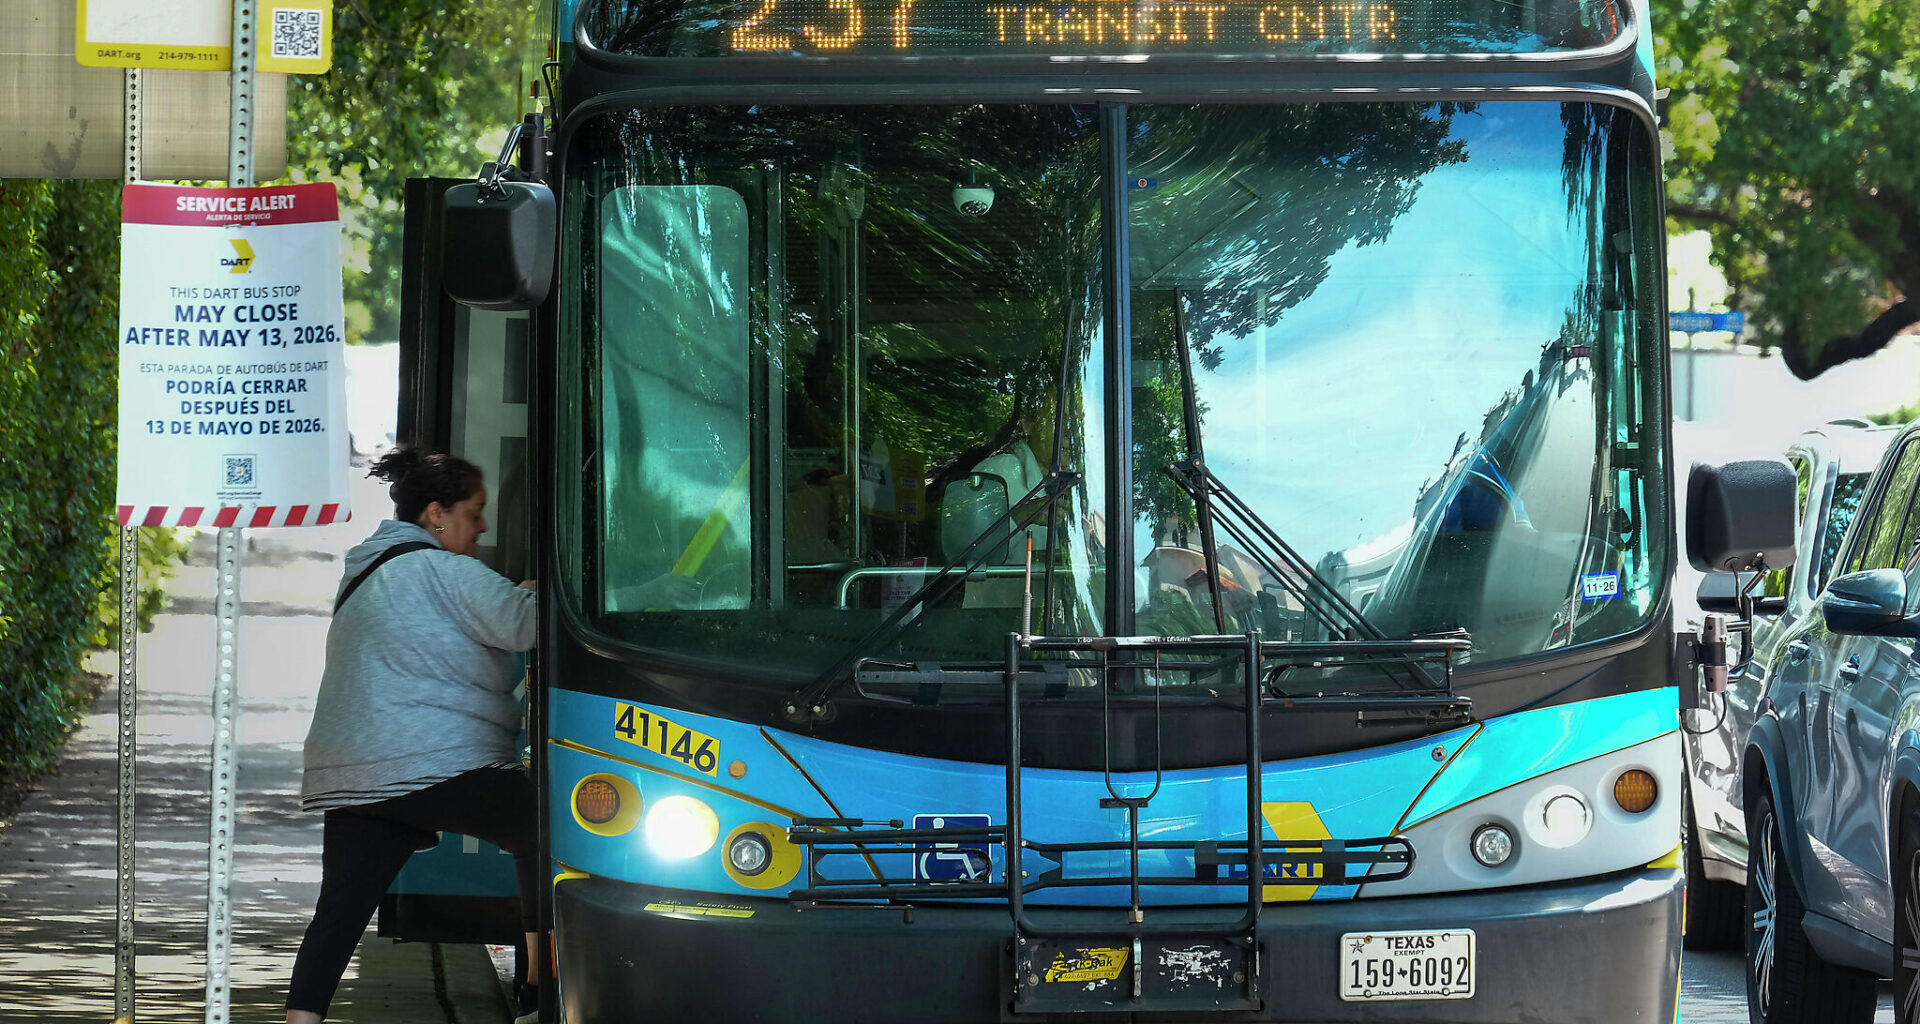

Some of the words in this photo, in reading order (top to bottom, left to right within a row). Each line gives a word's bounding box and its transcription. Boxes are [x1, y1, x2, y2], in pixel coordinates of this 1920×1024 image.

[986, 6, 1226, 42] TRANSIT
[1259, 4, 1396, 40] CNTR
[97, 49, 141, 60] DART.org
[158, 51, 219, 61] 214-979-1111
[176, 196, 246, 212] SERVICE
[250, 194, 296, 212] ALERT
[206, 213, 232, 221] ALERTA
[233, 213, 243, 221] DE
[244, 212, 271, 221] SERVICIO
[220, 258, 251, 266] DART
[170, 286, 198, 298] THIS
[203, 287, 238, 299] DART
[243, 287, 268, 299] BUS
[272, 285, 300, 297] STOP
[175, 305, 225, 323] MAY
[234, 303, 298, 322] CLOSE
[126, 327, 191, 346] AFTER
[199, 329, 251, 347] MAY
[258, 327, 288, 349] 13,
[293, 325, 341, 344] 2026.
[140, 363, 164, 373] ESTA
[168, 364, 213, 375] PARADA
[217, 364, 231, 375] DE
[235, 361, 287, 375] AUTOBÚS
[290, 362, 302, 373] DE
[305, 361, 328, 372] DART
[166, 376, 236, 395] PODRÍA
[241, 379, 308, 394] CERRAR
[180, 397, 259, 415] DESPUÉS
[265, 399, 295, 414] DEL
[146, 420, 165, 434] 13
[171, 421, 192, 435] DE
[199, 421, 252, 435] MAYO
[259, 420, 280, 434] DE
[285, 418, 325, 434] 2026.
[1586, 581, 1615, 593] 11-26
[615, 705, 716, 773] 41146
[1385, 936, 1435, 949] TEXAS
